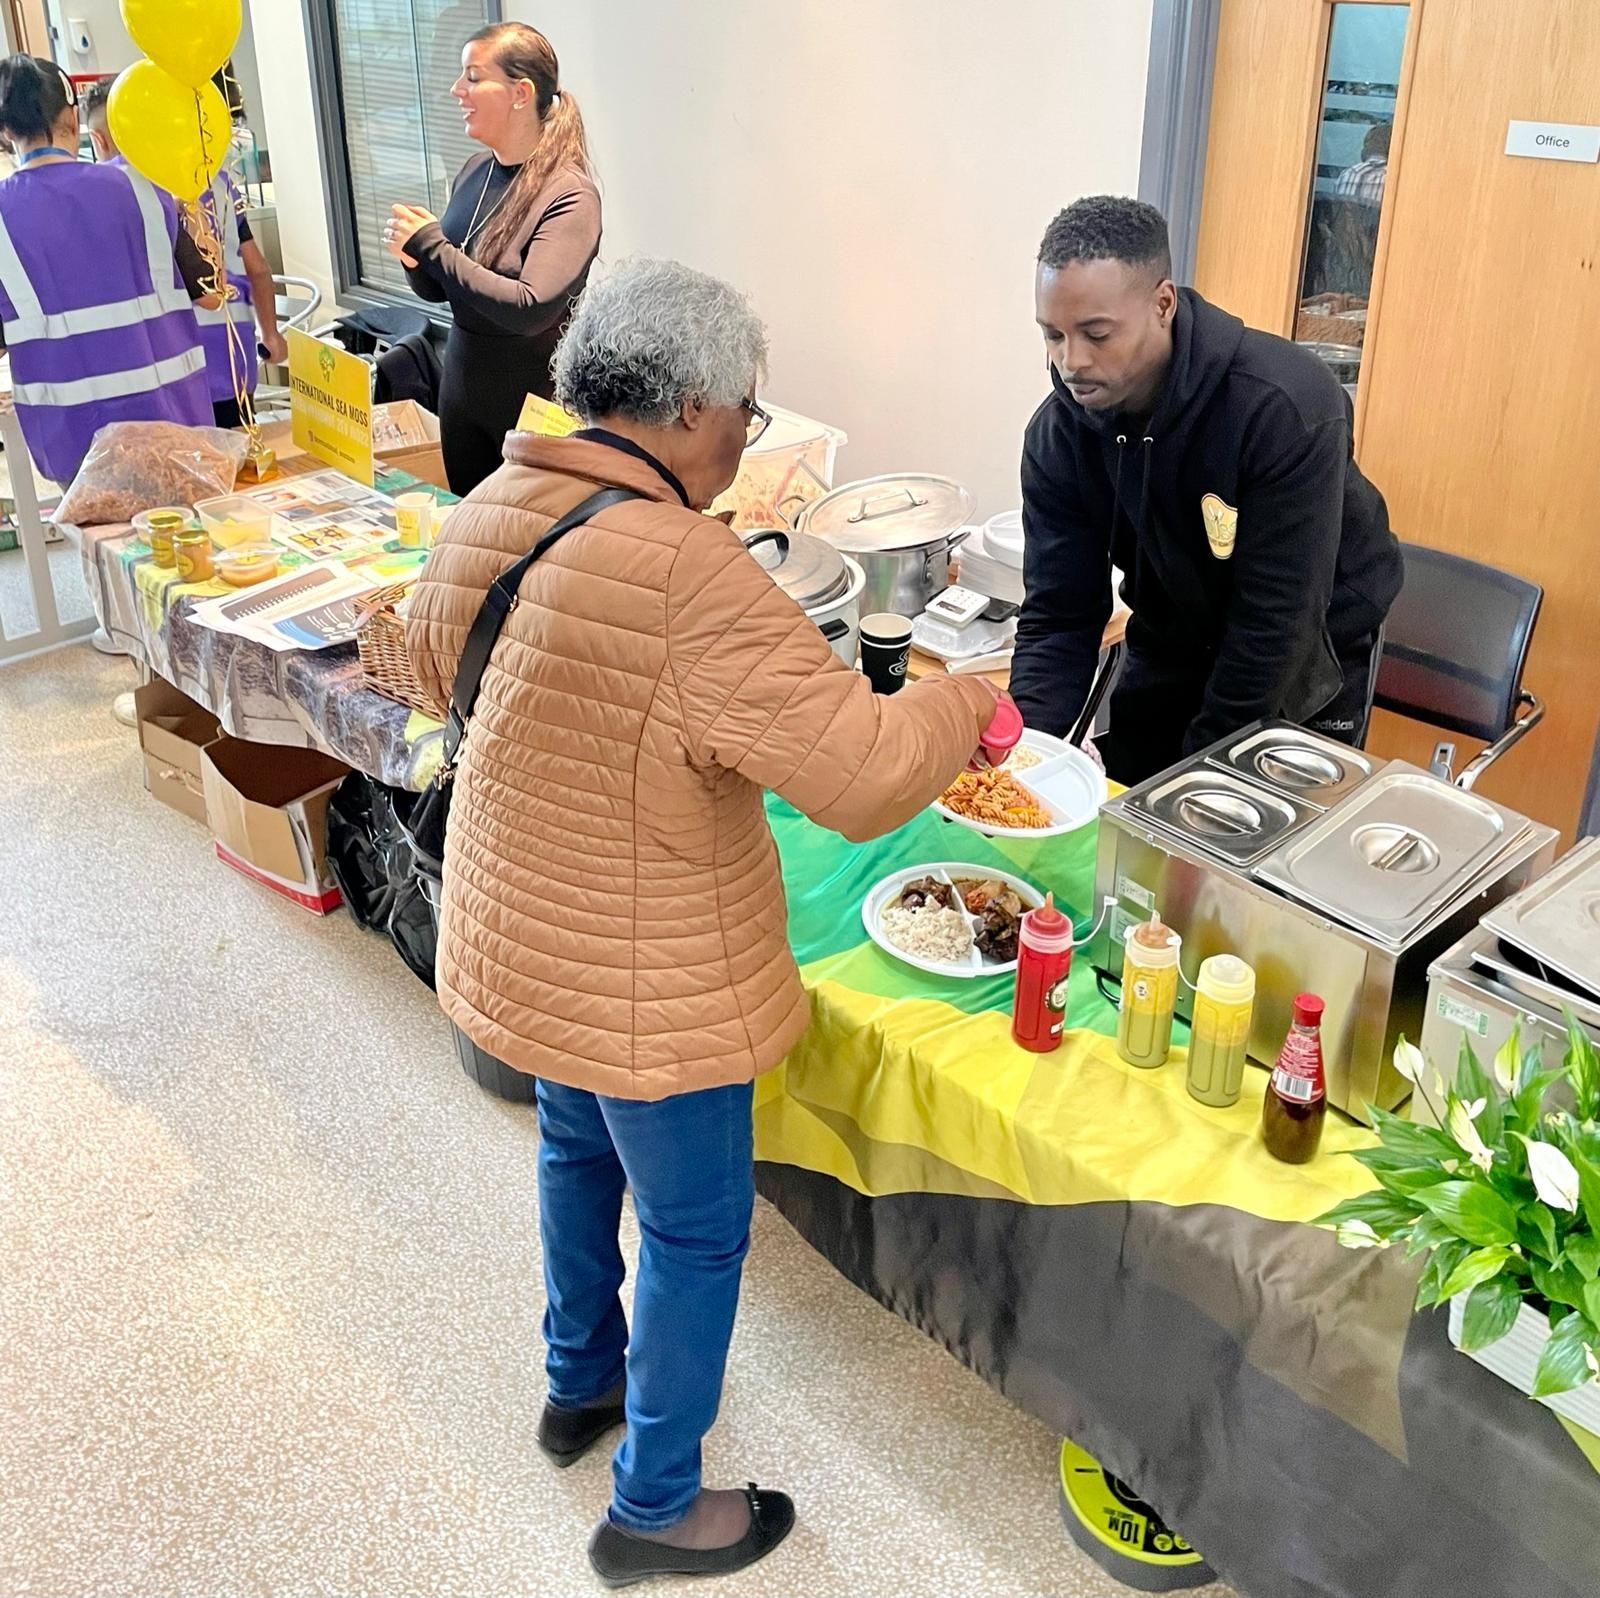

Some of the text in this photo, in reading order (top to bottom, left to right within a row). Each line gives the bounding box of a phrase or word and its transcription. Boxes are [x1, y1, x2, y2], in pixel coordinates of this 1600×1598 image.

[1535, 134, 1570, 148] Office
[335, 398, 348, 417] SEA
[348, 404, 369, 428] MOSS
[1311, 719, 1354, 730] adidas
[1108, 1516, 1140, 1545] 10M
